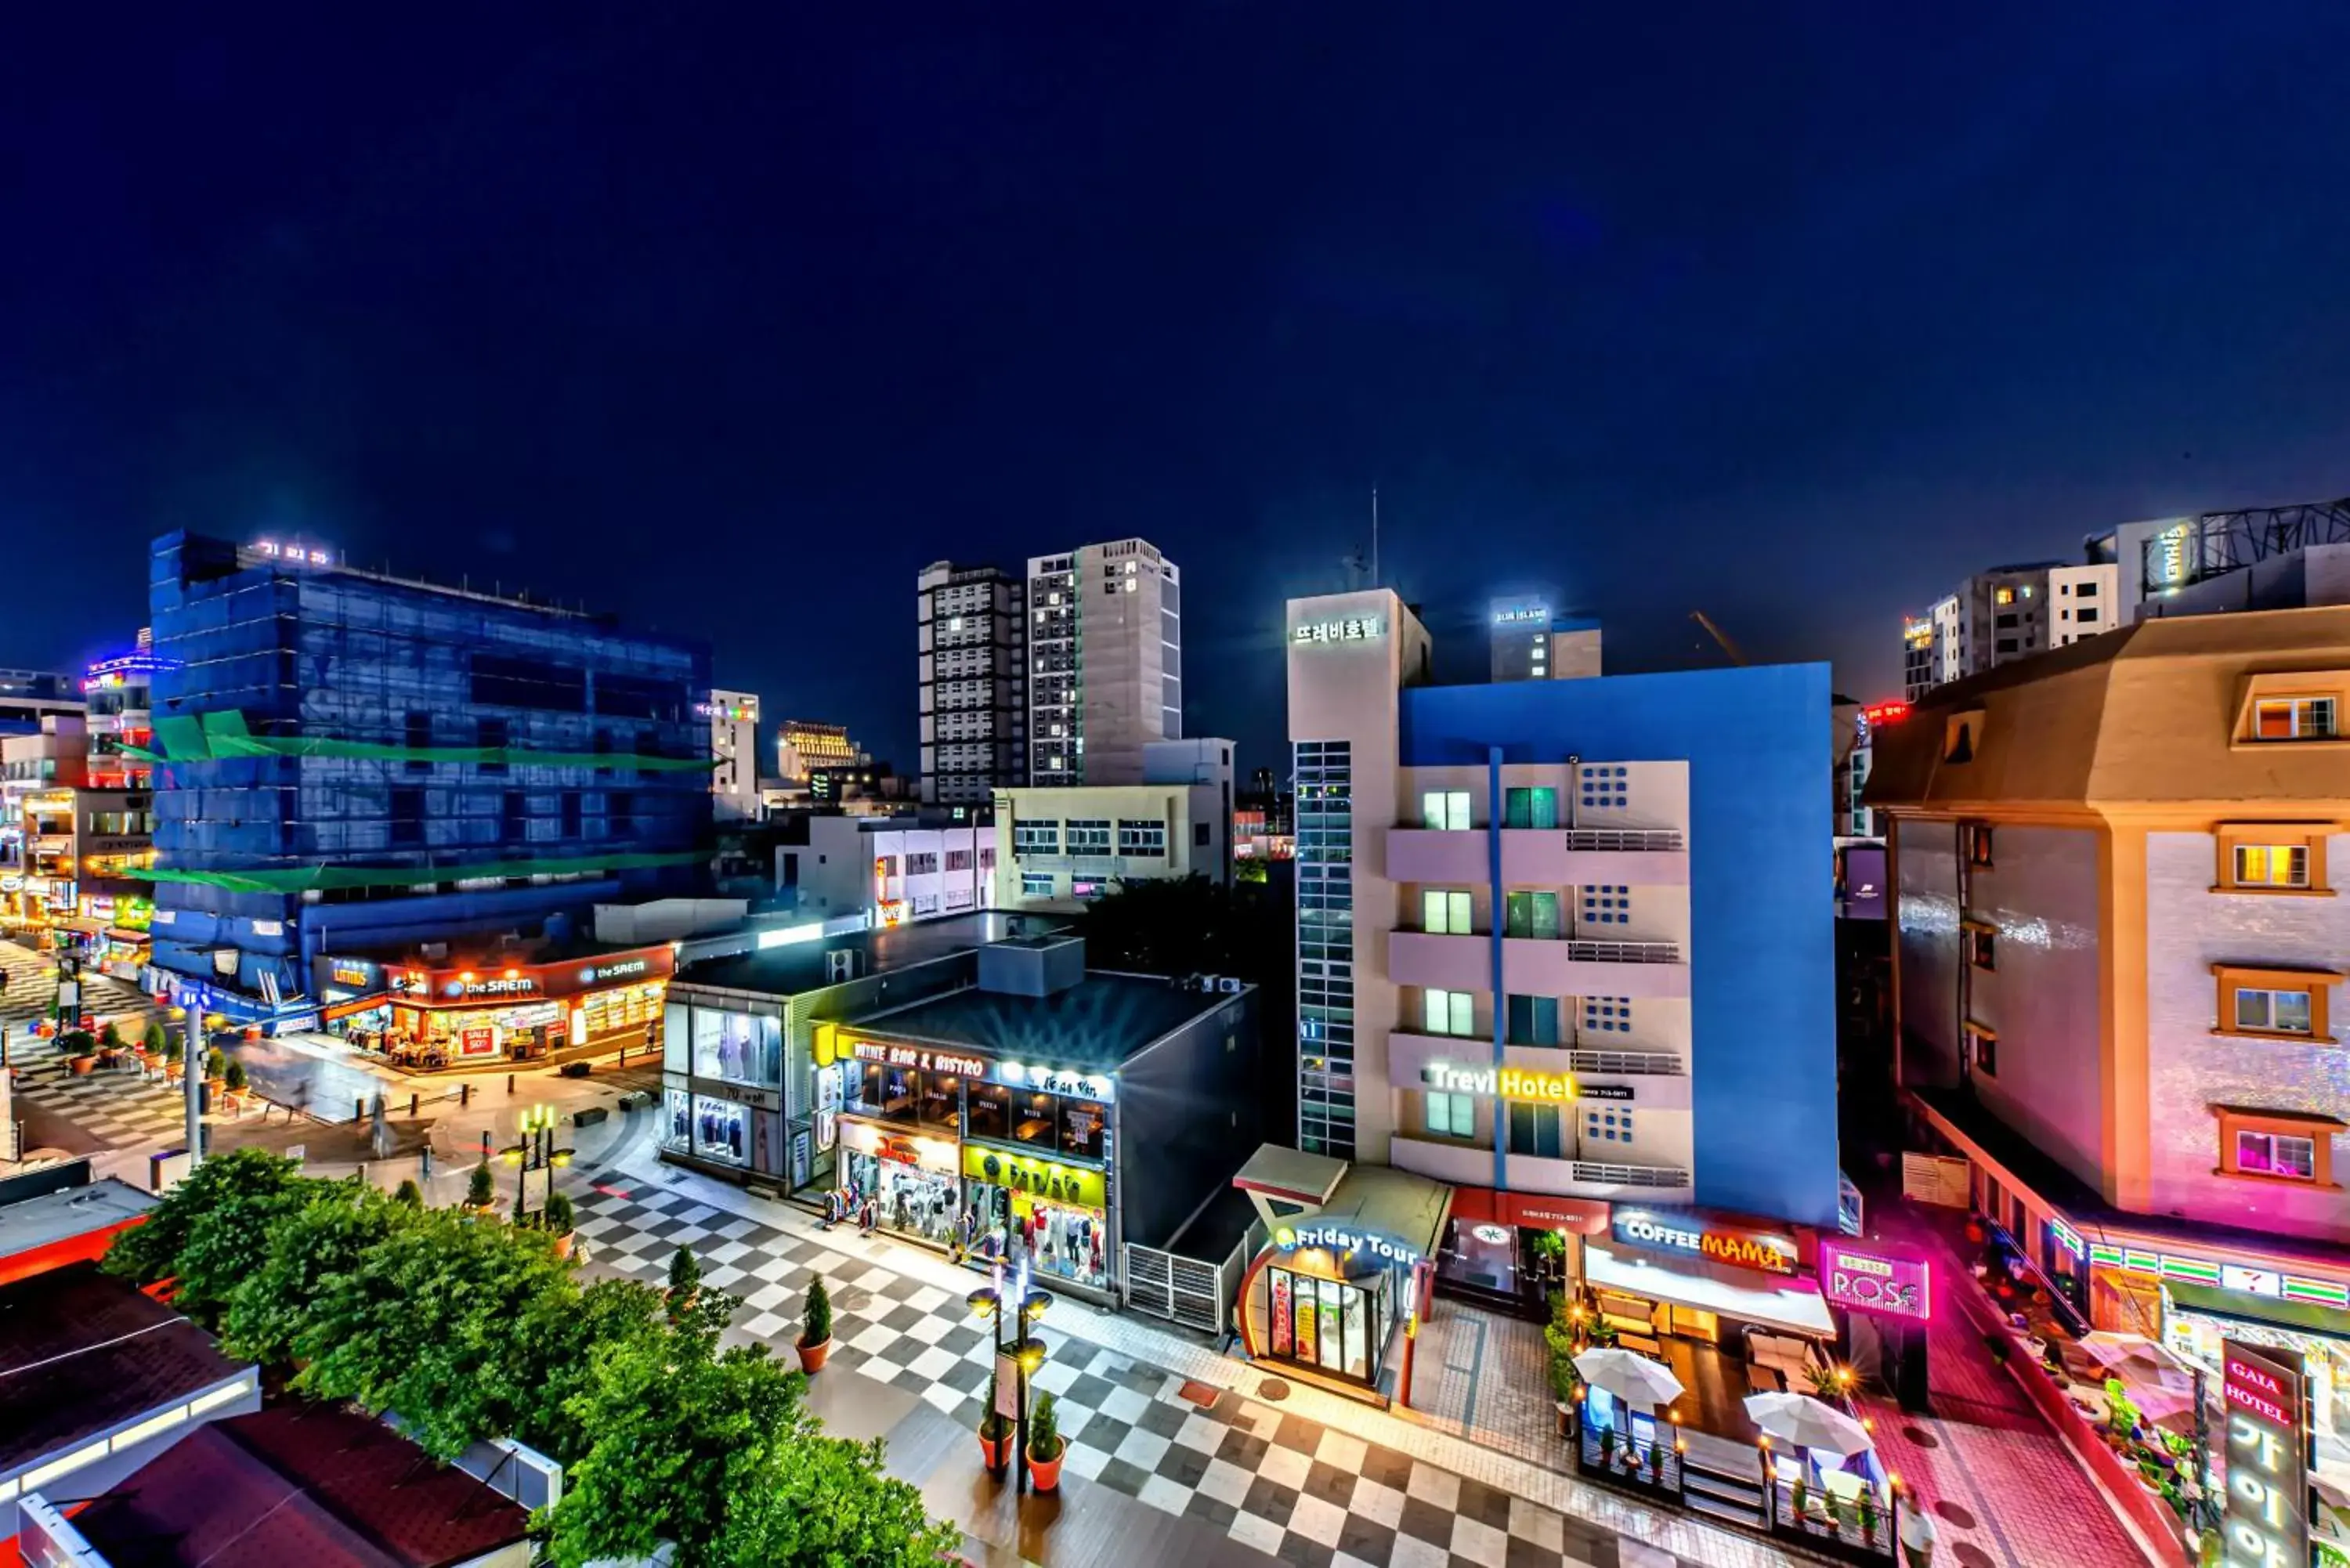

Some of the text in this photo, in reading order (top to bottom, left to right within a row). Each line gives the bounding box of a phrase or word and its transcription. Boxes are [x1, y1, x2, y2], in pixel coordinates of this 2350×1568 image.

[1296, 617, 1379, 643] 뜨레비호텔
[466, 1029, 490, 1039] SALE
[854, 1042, 984, 1077] WINE BAR & BISTRO
[1430, 1062, 1574, 1100] Trevi Hotel
[1296, 1227, 1419, 1265] Friday Tour
[1626, 1219, 1784, 1270] COFFEE MAMA
[1833, 1271, 1918, 1310] ROSE
[2231, 1361, 2281, 1396] GAIA
[2225, 1382, 2291, 1426] HOTEL
